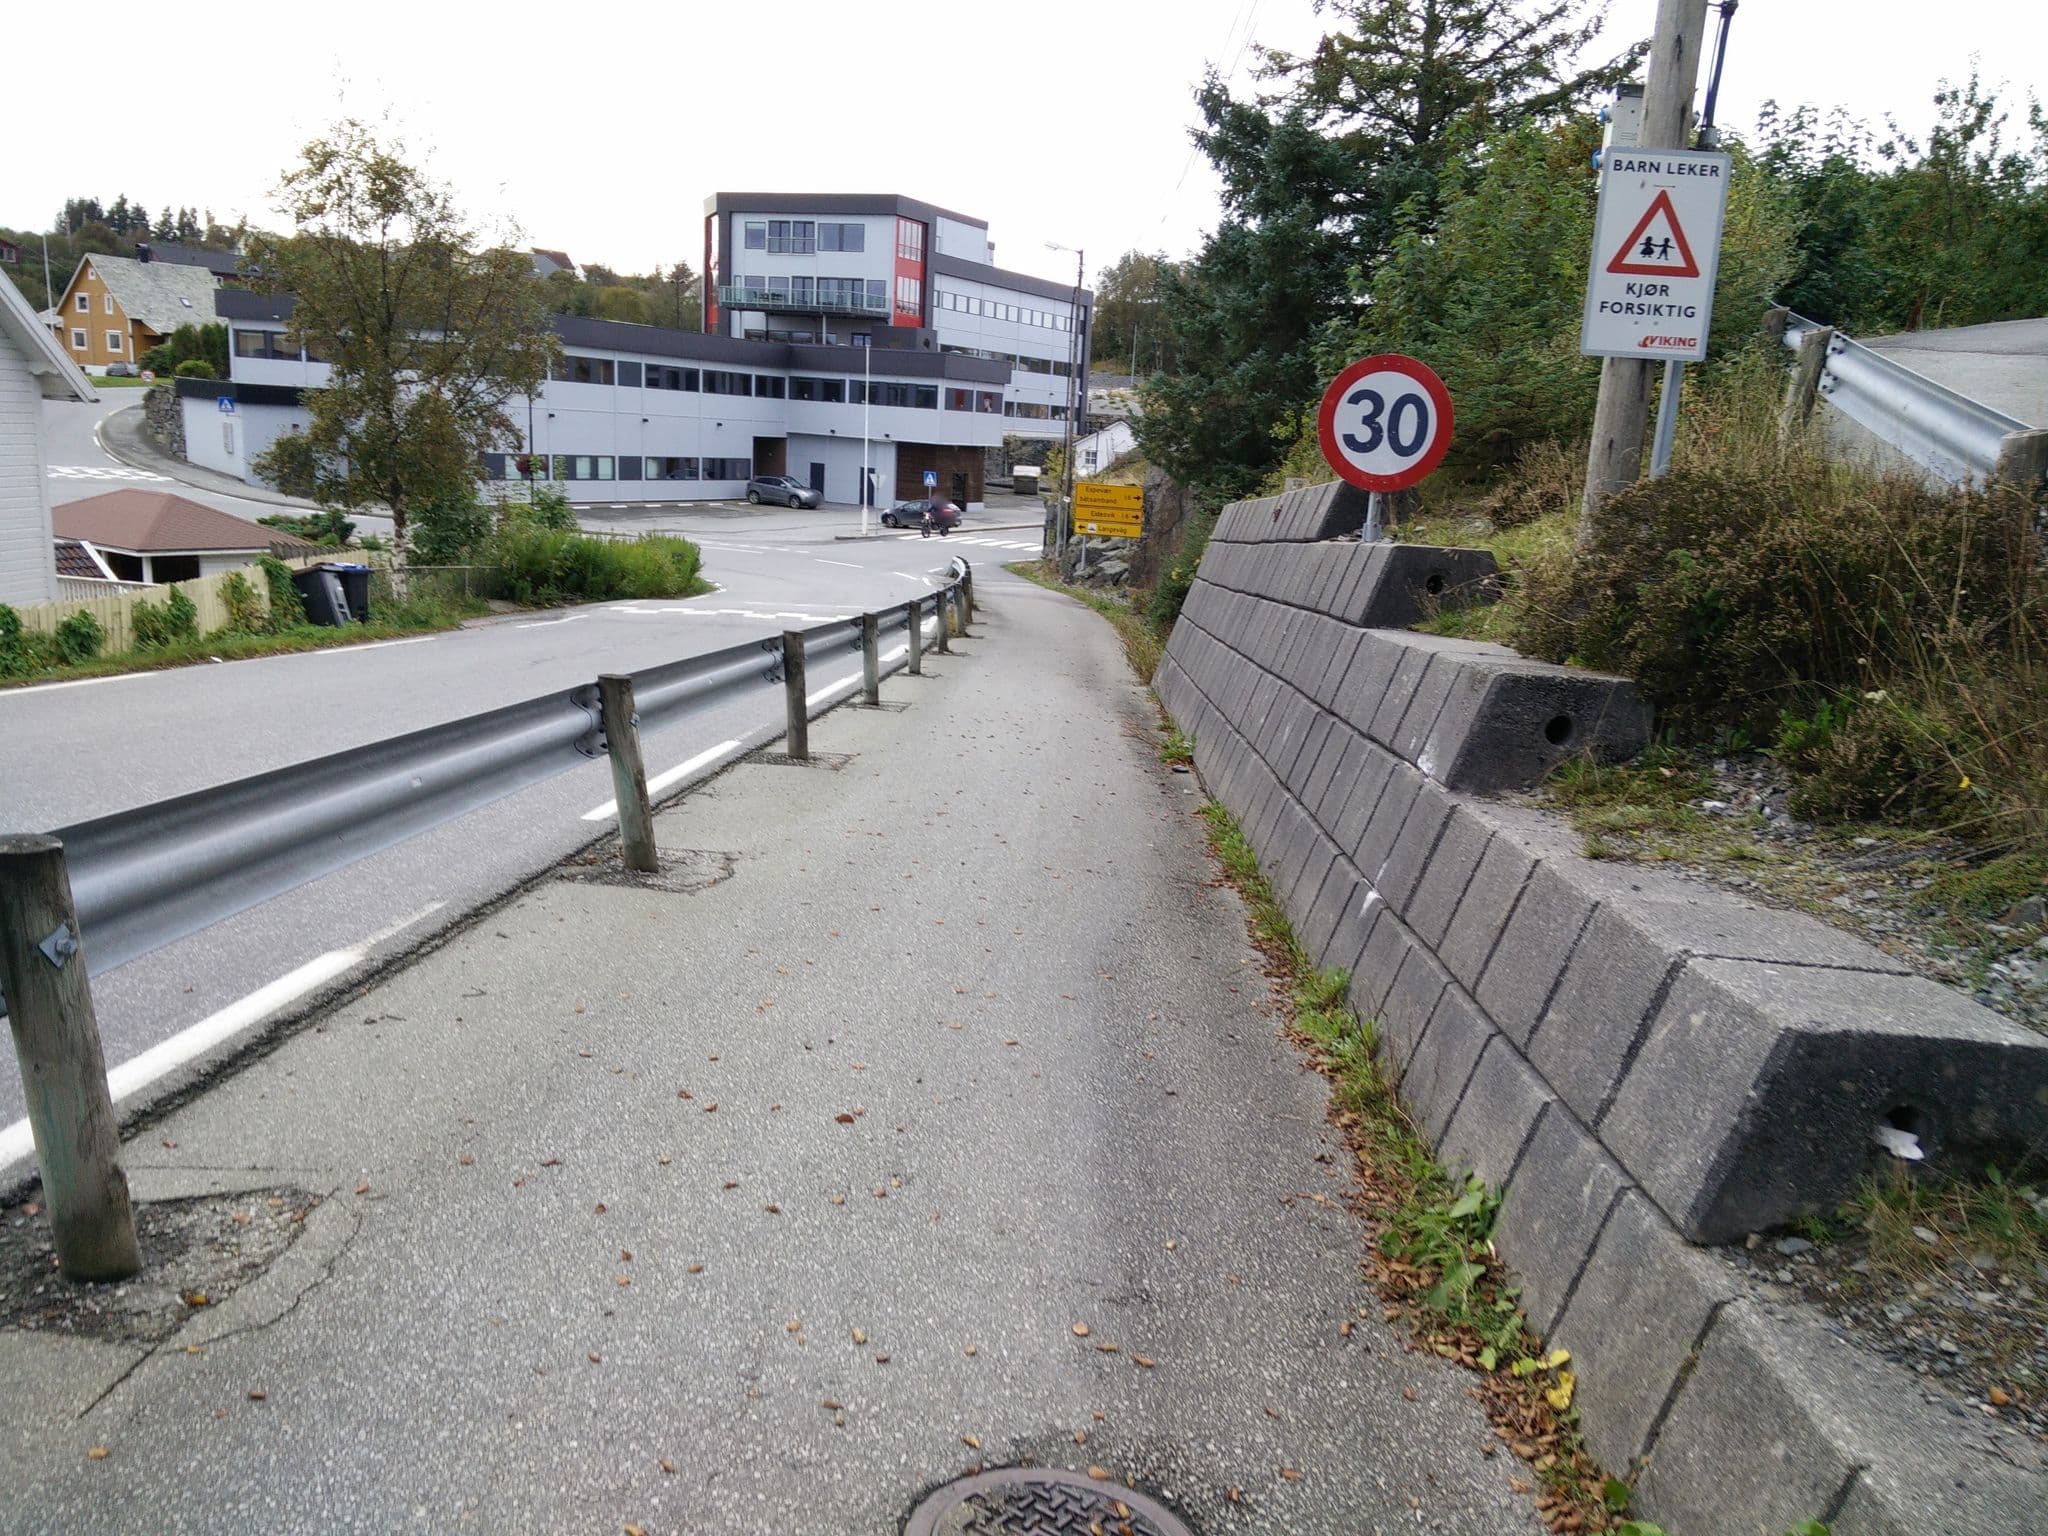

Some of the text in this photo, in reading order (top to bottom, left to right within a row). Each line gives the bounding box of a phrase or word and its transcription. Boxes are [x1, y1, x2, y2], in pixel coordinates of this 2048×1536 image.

[1613, 159, 1720, 177] BARN LEKER
[1626, 282, 1670, 297] KJØR
[1599, 301, 1696, 318] FORSIKTIG
[1648, 335, 1697, 348] VIKING
[1342, 389, 1429, 457] 30
